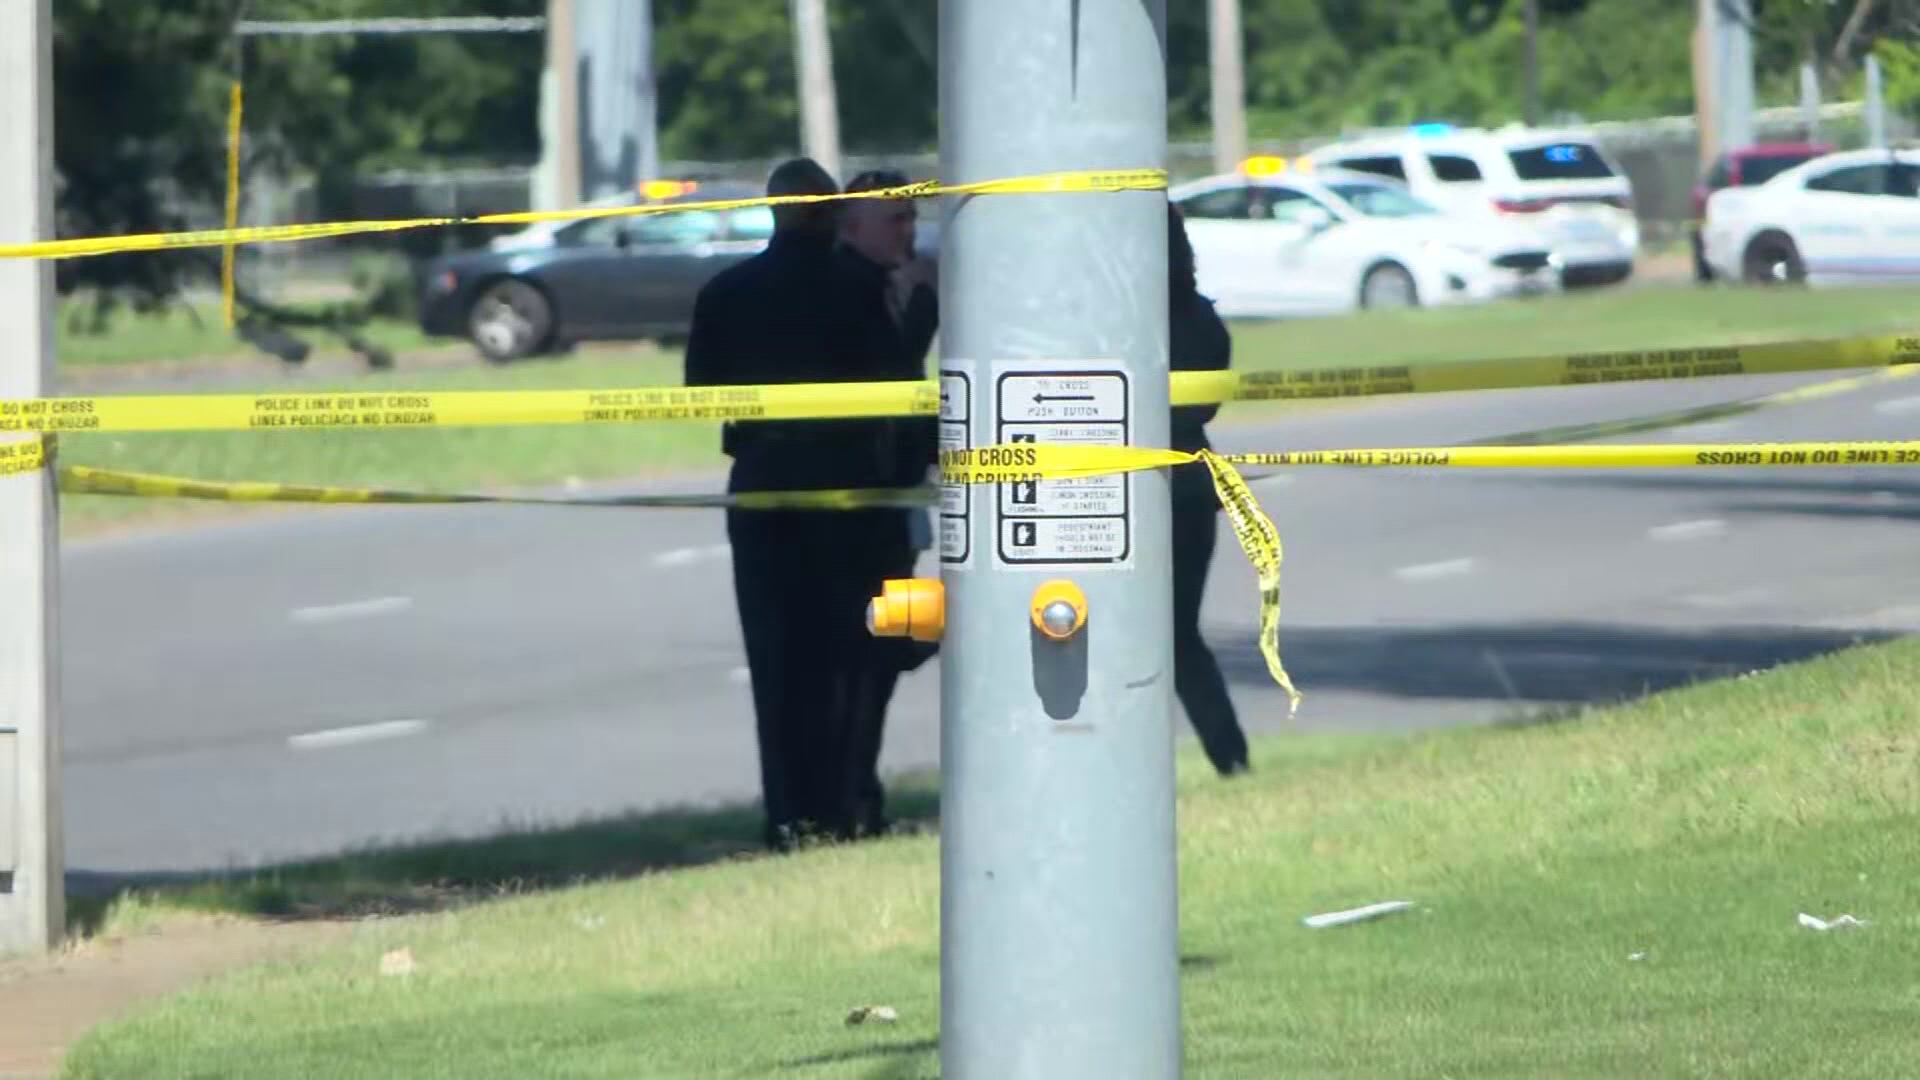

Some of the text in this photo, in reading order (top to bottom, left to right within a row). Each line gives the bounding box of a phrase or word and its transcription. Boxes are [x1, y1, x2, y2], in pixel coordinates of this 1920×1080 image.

[52, 400, 95, 413] CROSS
[255, 399, 299, 411] POLICE
[305, 398, 332, 410] LINE
[359, 397, 383, 408] NOT
[387, 396, 430, 408] CROSS
[362, 412, 381, 424] NO
[953, 448, 974, 466] NOT
[980, 448, 1036, 466] CROSS
[1332, 452, 1373, 465] LINE
[1380, 452, 1449, 465] POLICE
[1696, 451, 1761, 465] CROSS
[1768, 451, 1806, 464] NOT
[1812, 450, 1839, 464] DO
[1847, 450, 1888, 463] LINE
